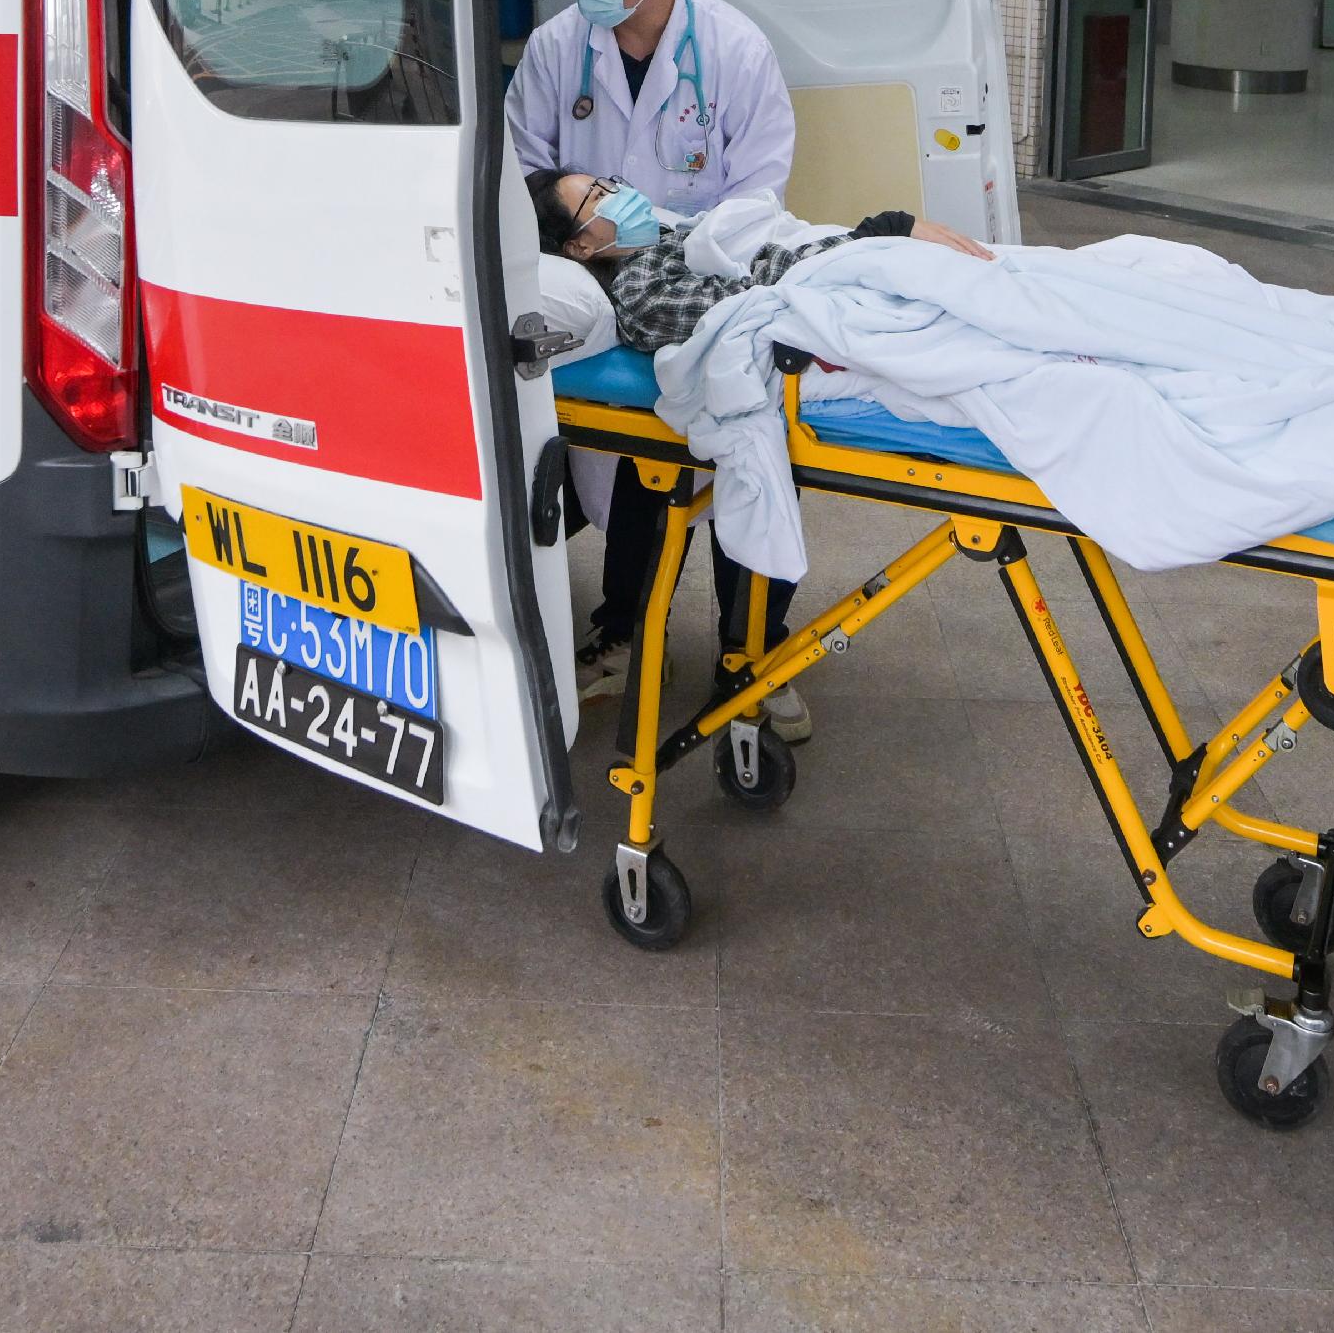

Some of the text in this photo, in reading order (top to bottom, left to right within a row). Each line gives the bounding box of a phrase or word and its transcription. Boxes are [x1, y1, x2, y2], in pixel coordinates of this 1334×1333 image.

[162, 385, 260, 428] TRANSIT
[205, 501, 376, 613] WL 1116
[239, 657, 436, 788] AA-24-77
